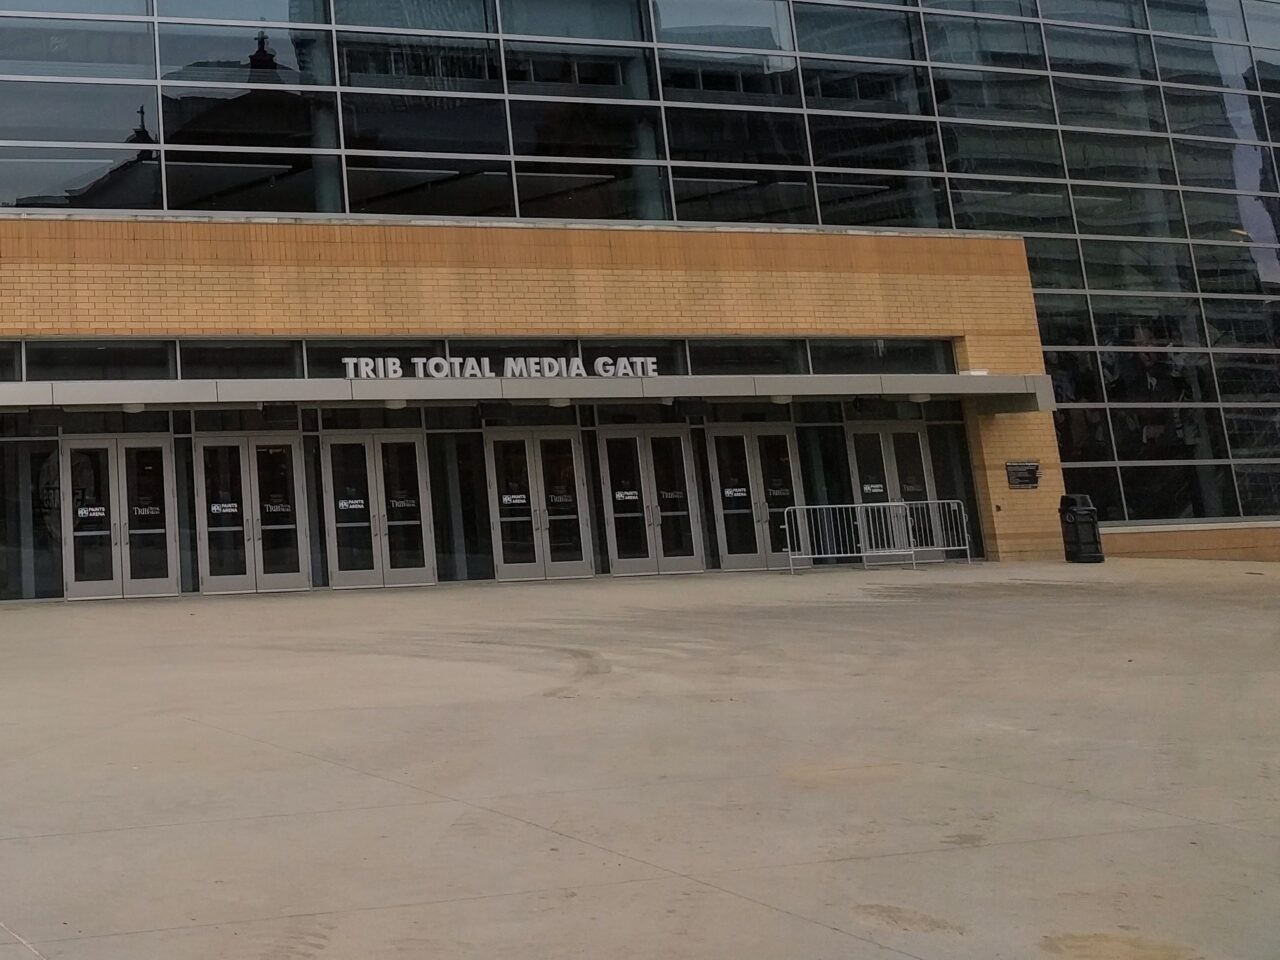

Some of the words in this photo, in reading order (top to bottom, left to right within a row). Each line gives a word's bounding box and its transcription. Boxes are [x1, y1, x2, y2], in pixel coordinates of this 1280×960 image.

[342, 356, 403, 378] TRIB
[411, 356, 496, 378] TOTAL
[503, 356, 588, 378] MEDIA
[594, 356, 658, 377] GATE
